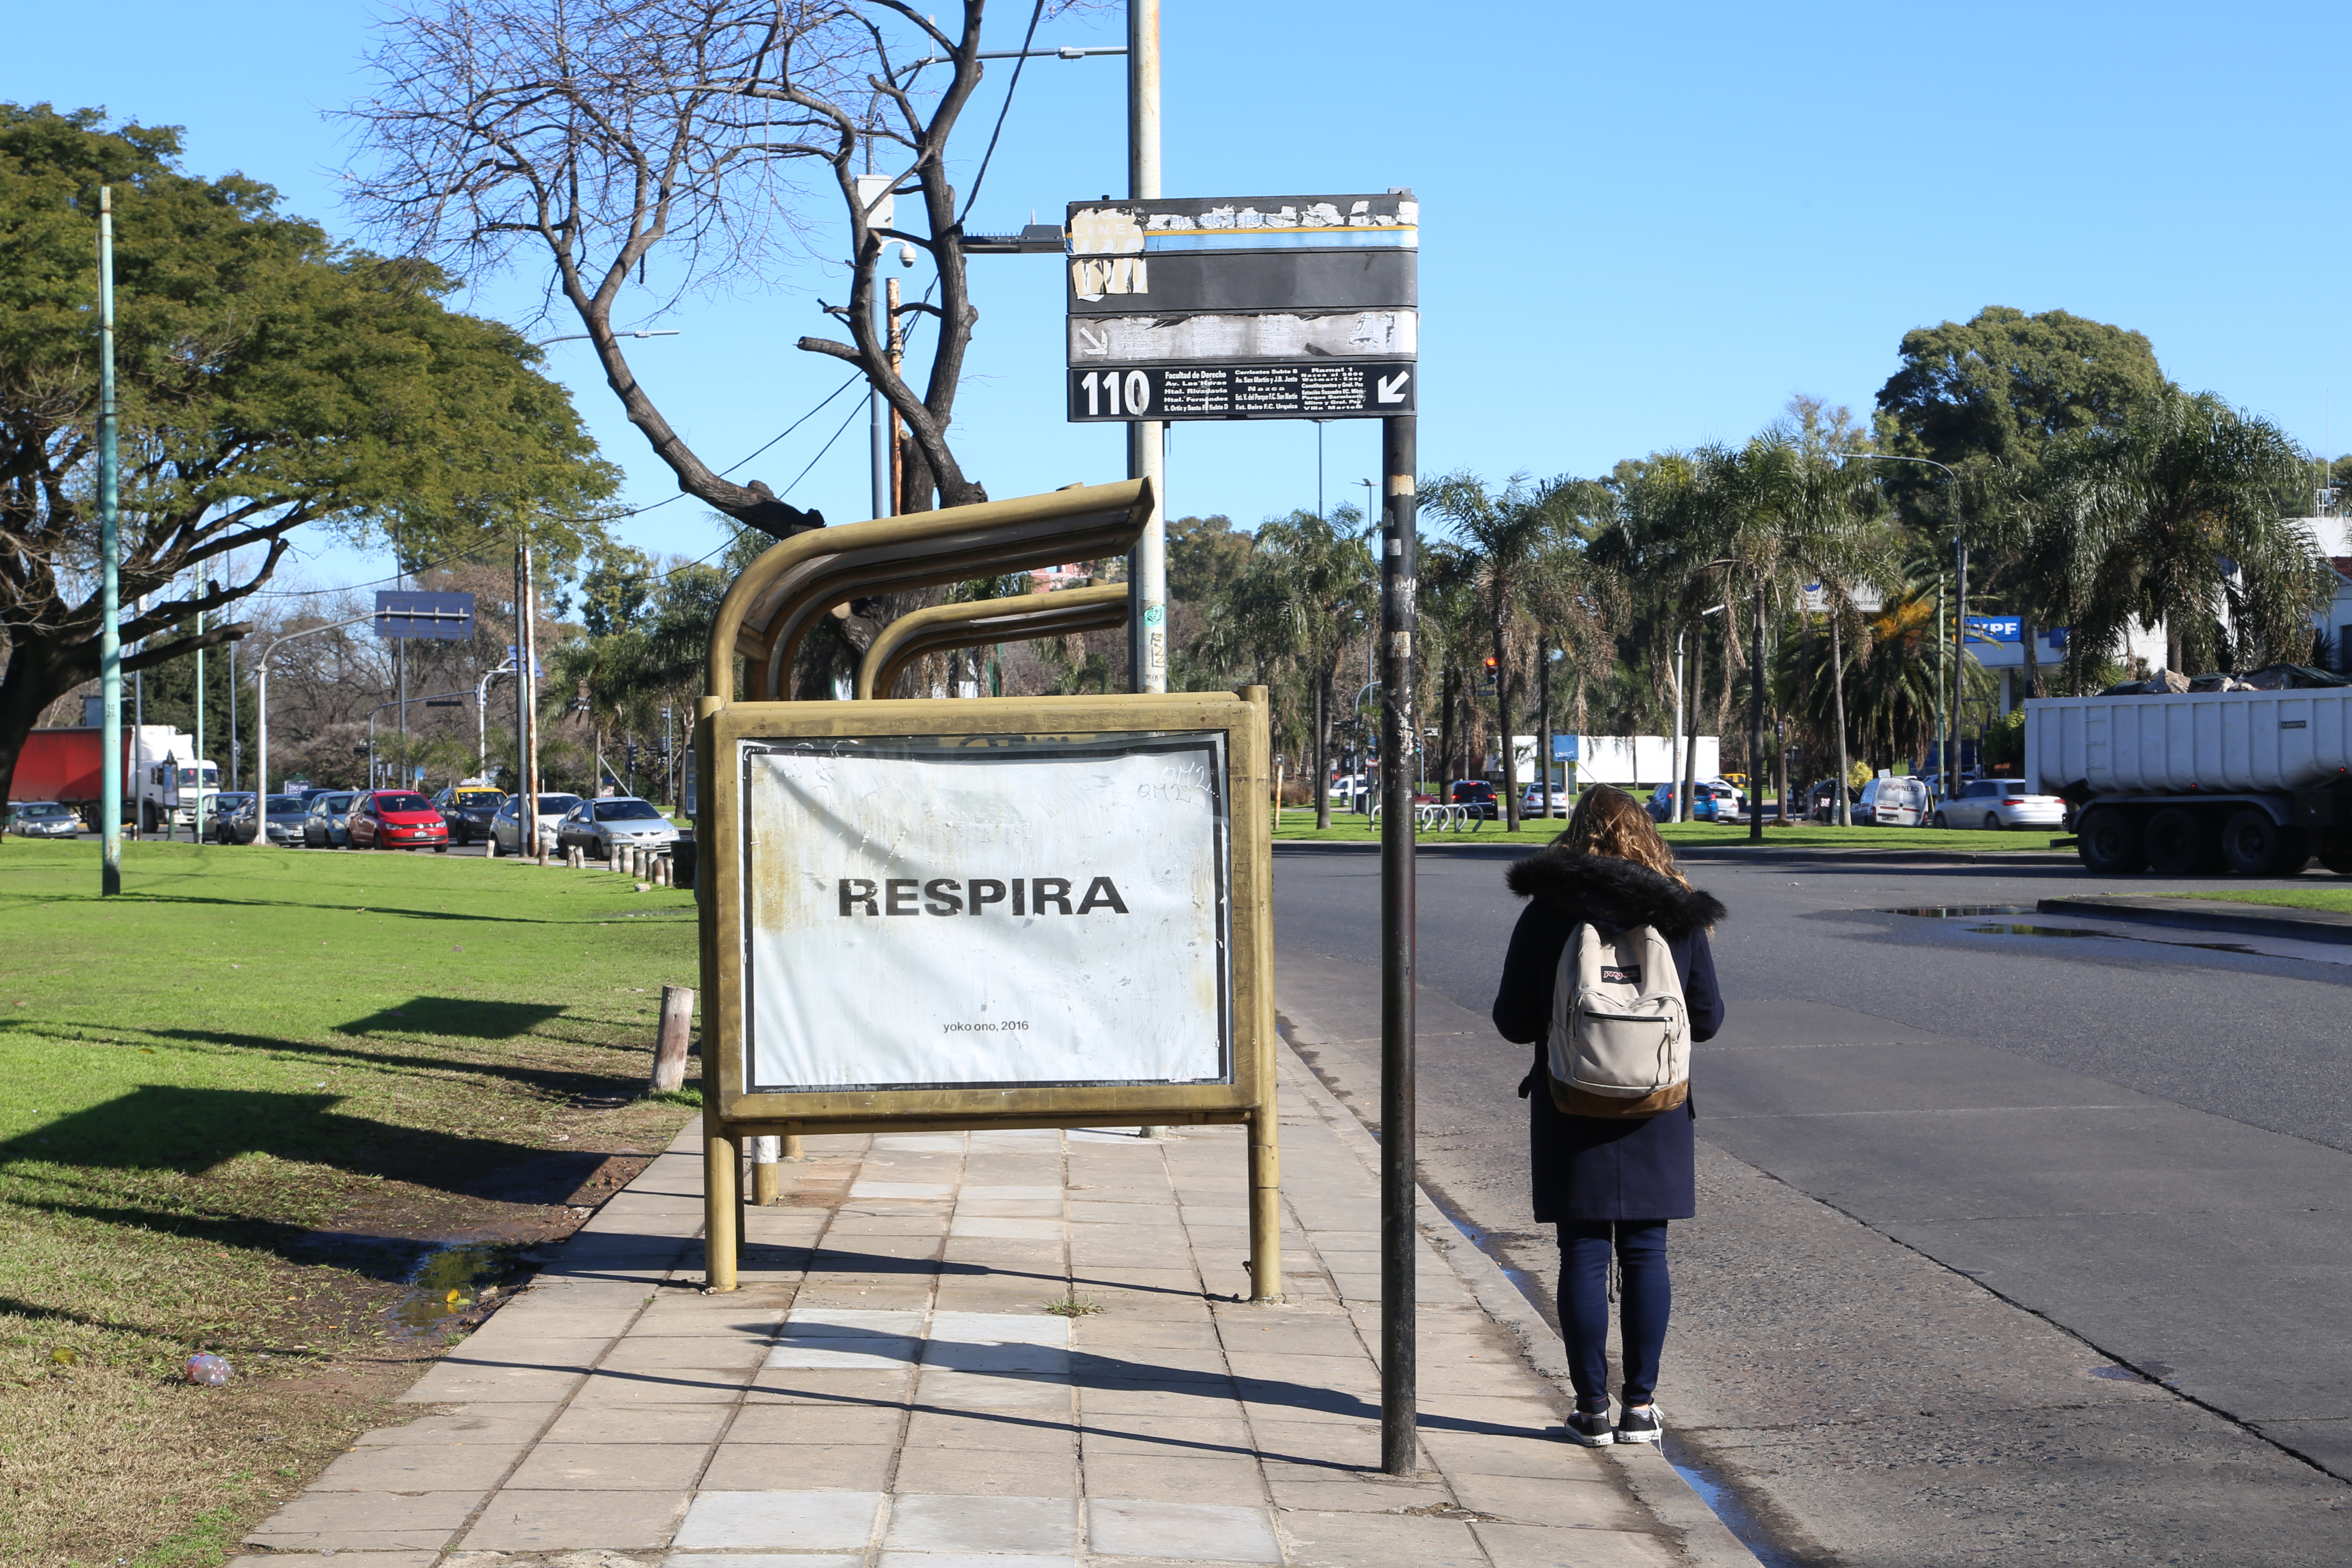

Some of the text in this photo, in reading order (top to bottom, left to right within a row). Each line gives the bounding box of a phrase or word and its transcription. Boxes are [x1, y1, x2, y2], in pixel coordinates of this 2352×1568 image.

[1074, 224, 1143, 236] LINEA
[1165, 371, 1191, 379] Facultad
[1201, 370, 1227, 378] Derecho
[1081, 370, 1150, 415] 110
[1254, 393, 1268, 401] Parque
[1973, 622, 2018, 635] YPF
[838, 876, 1130, 916] RESPIRA
[1603, 971, 1638, 980] JANSPORT
[943, 1020, 1029, 1034] yoko ono, 2016
